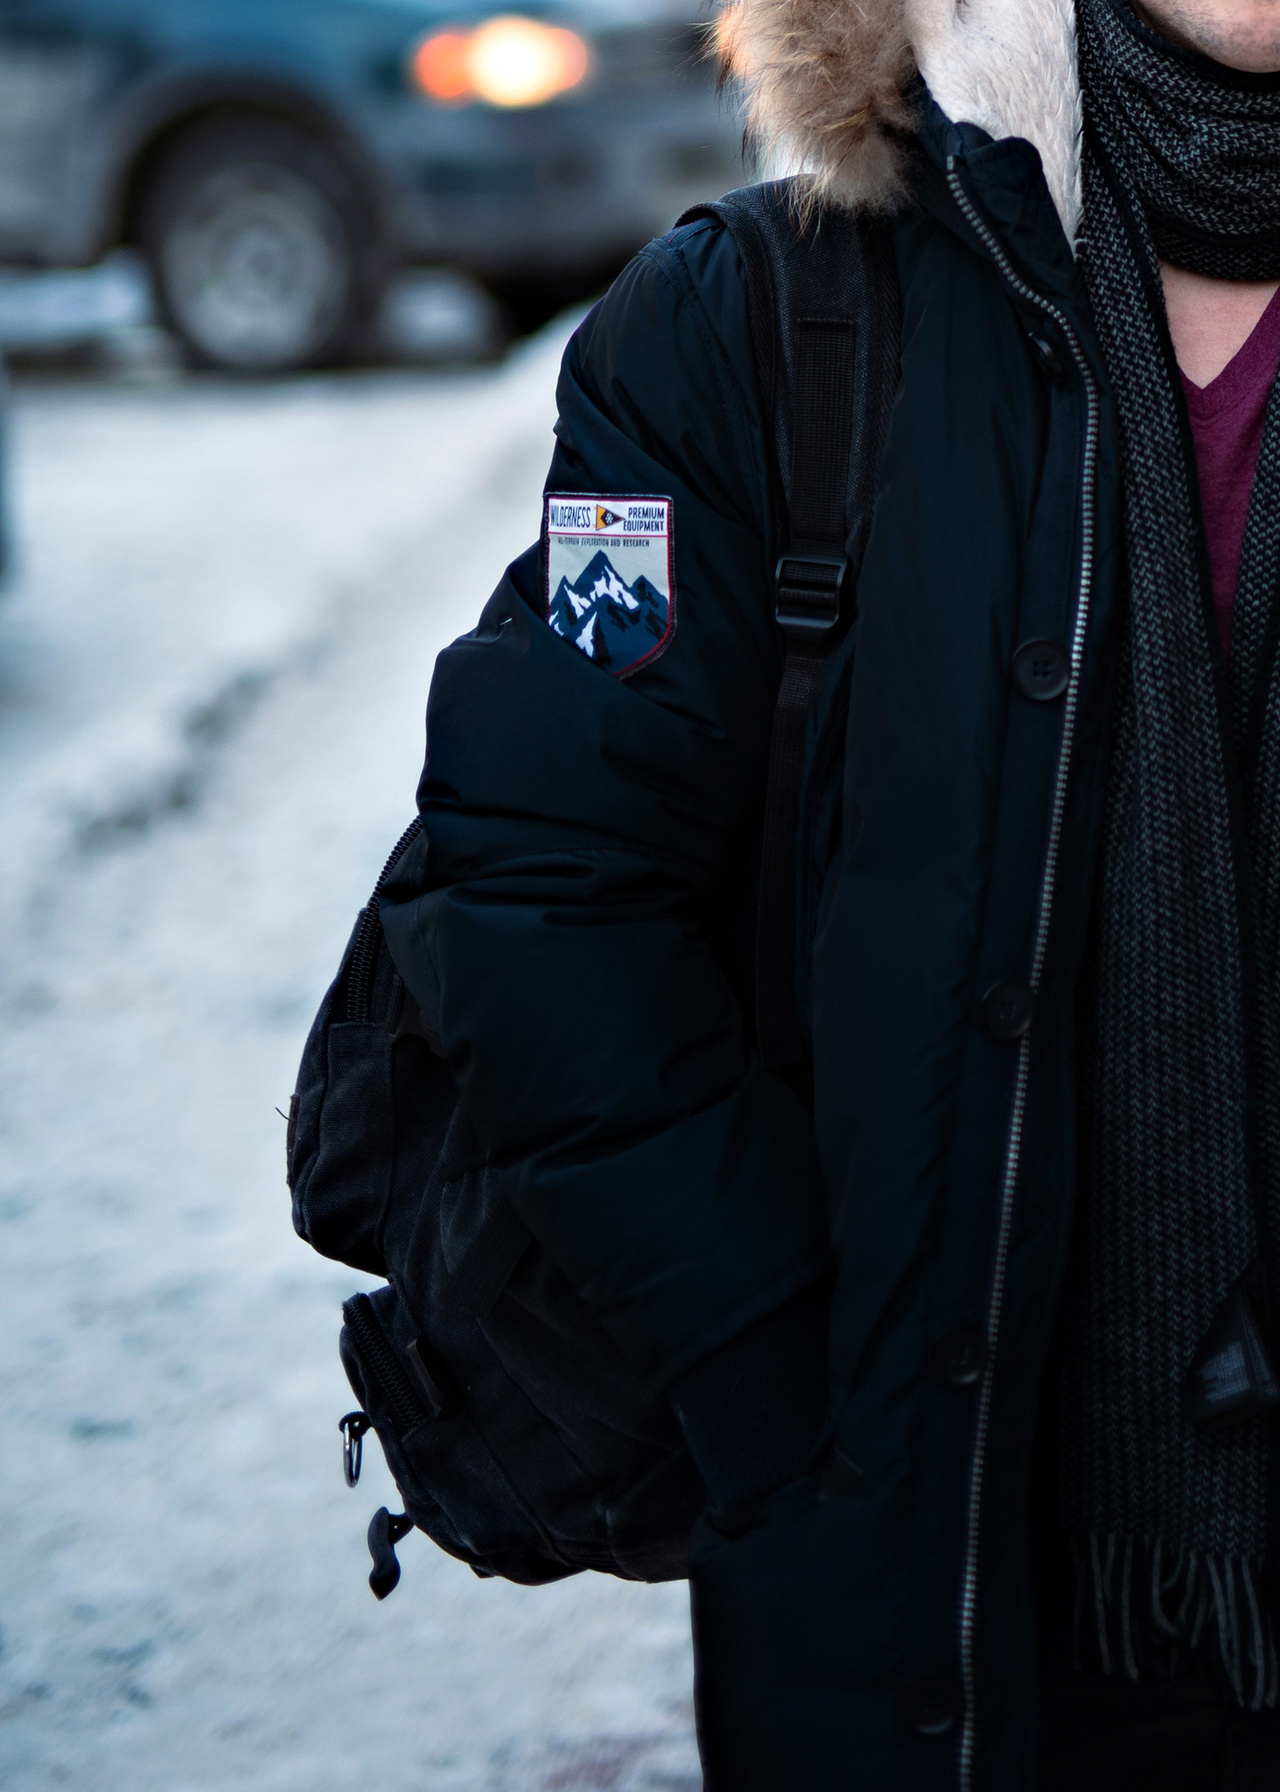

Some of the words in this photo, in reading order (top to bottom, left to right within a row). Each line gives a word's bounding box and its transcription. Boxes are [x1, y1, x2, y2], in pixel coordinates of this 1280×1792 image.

[550, 505, 591, 528] WILDERNESS
[628, 507, 665, 520] PREMIUM
[623, 520, 664, 532] EQUIPMENT
[610, 539, 621, 547] AND
[623, 539, 649, 547] RESEARCH
